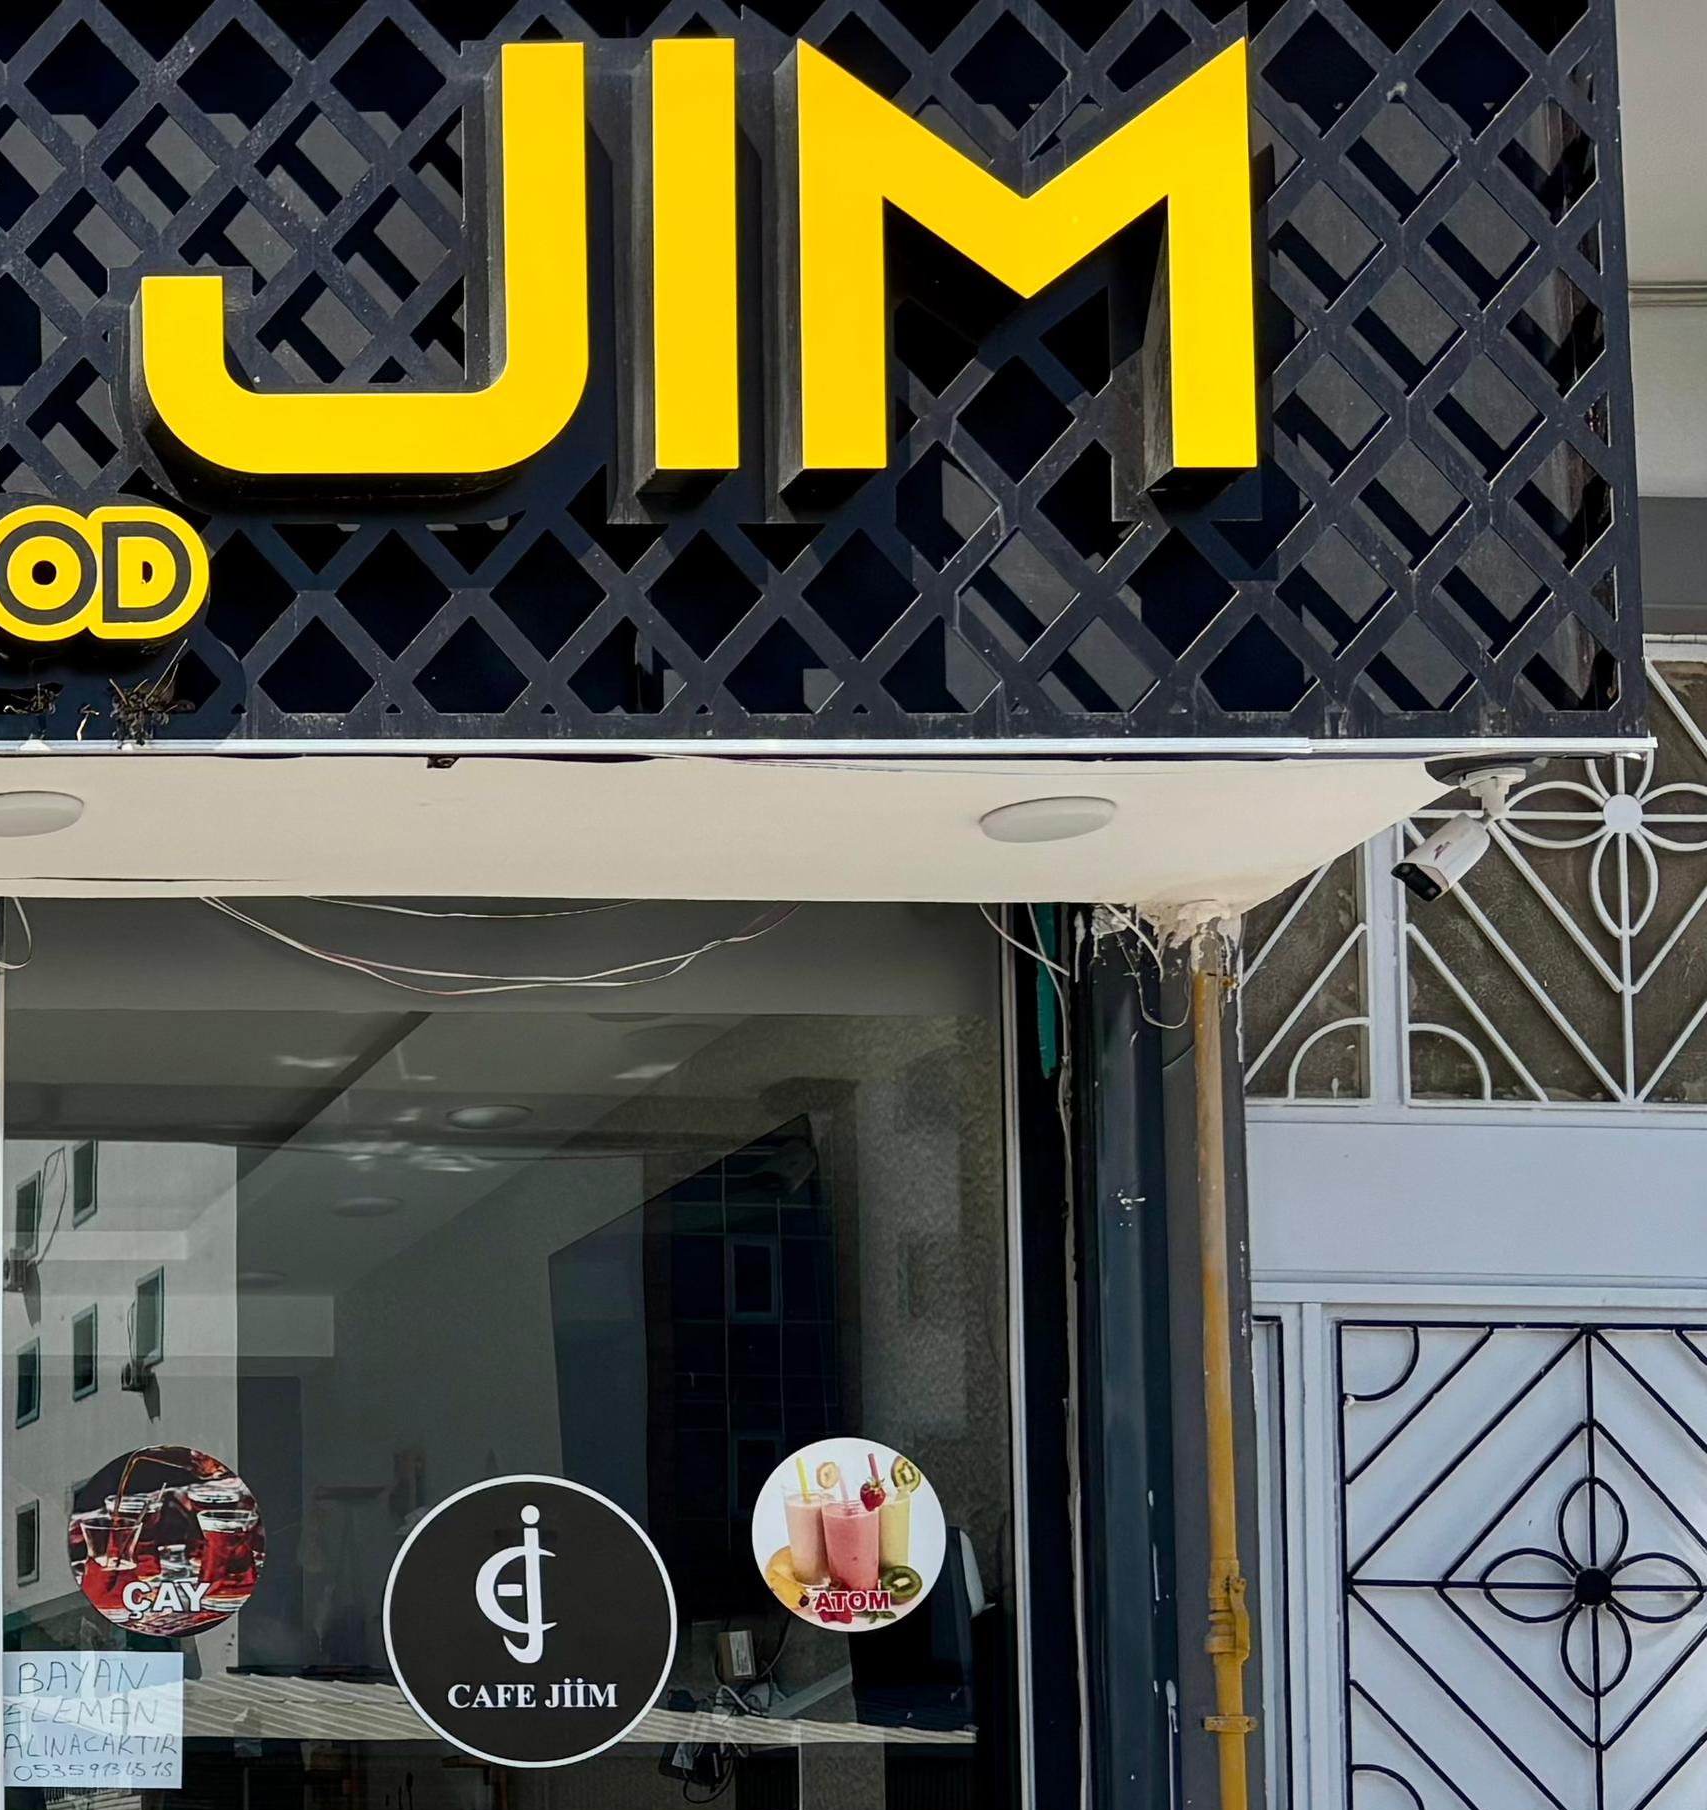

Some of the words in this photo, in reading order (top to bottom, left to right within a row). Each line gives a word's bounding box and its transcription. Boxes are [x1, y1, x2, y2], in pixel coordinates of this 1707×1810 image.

[138, 34, 1257, 474] JIM
[122, 1581, 211, 1619] ÇAY
[813, 1590, 891, 1613] ATOM
[19, 1659, 148, 1694] BAYAN
[447, 1683, 536, 1709] CAFE
[3, 1698, 158, 1726] ELEMAN
[3, 1733, 177, 1759] ALINACAKTIR
